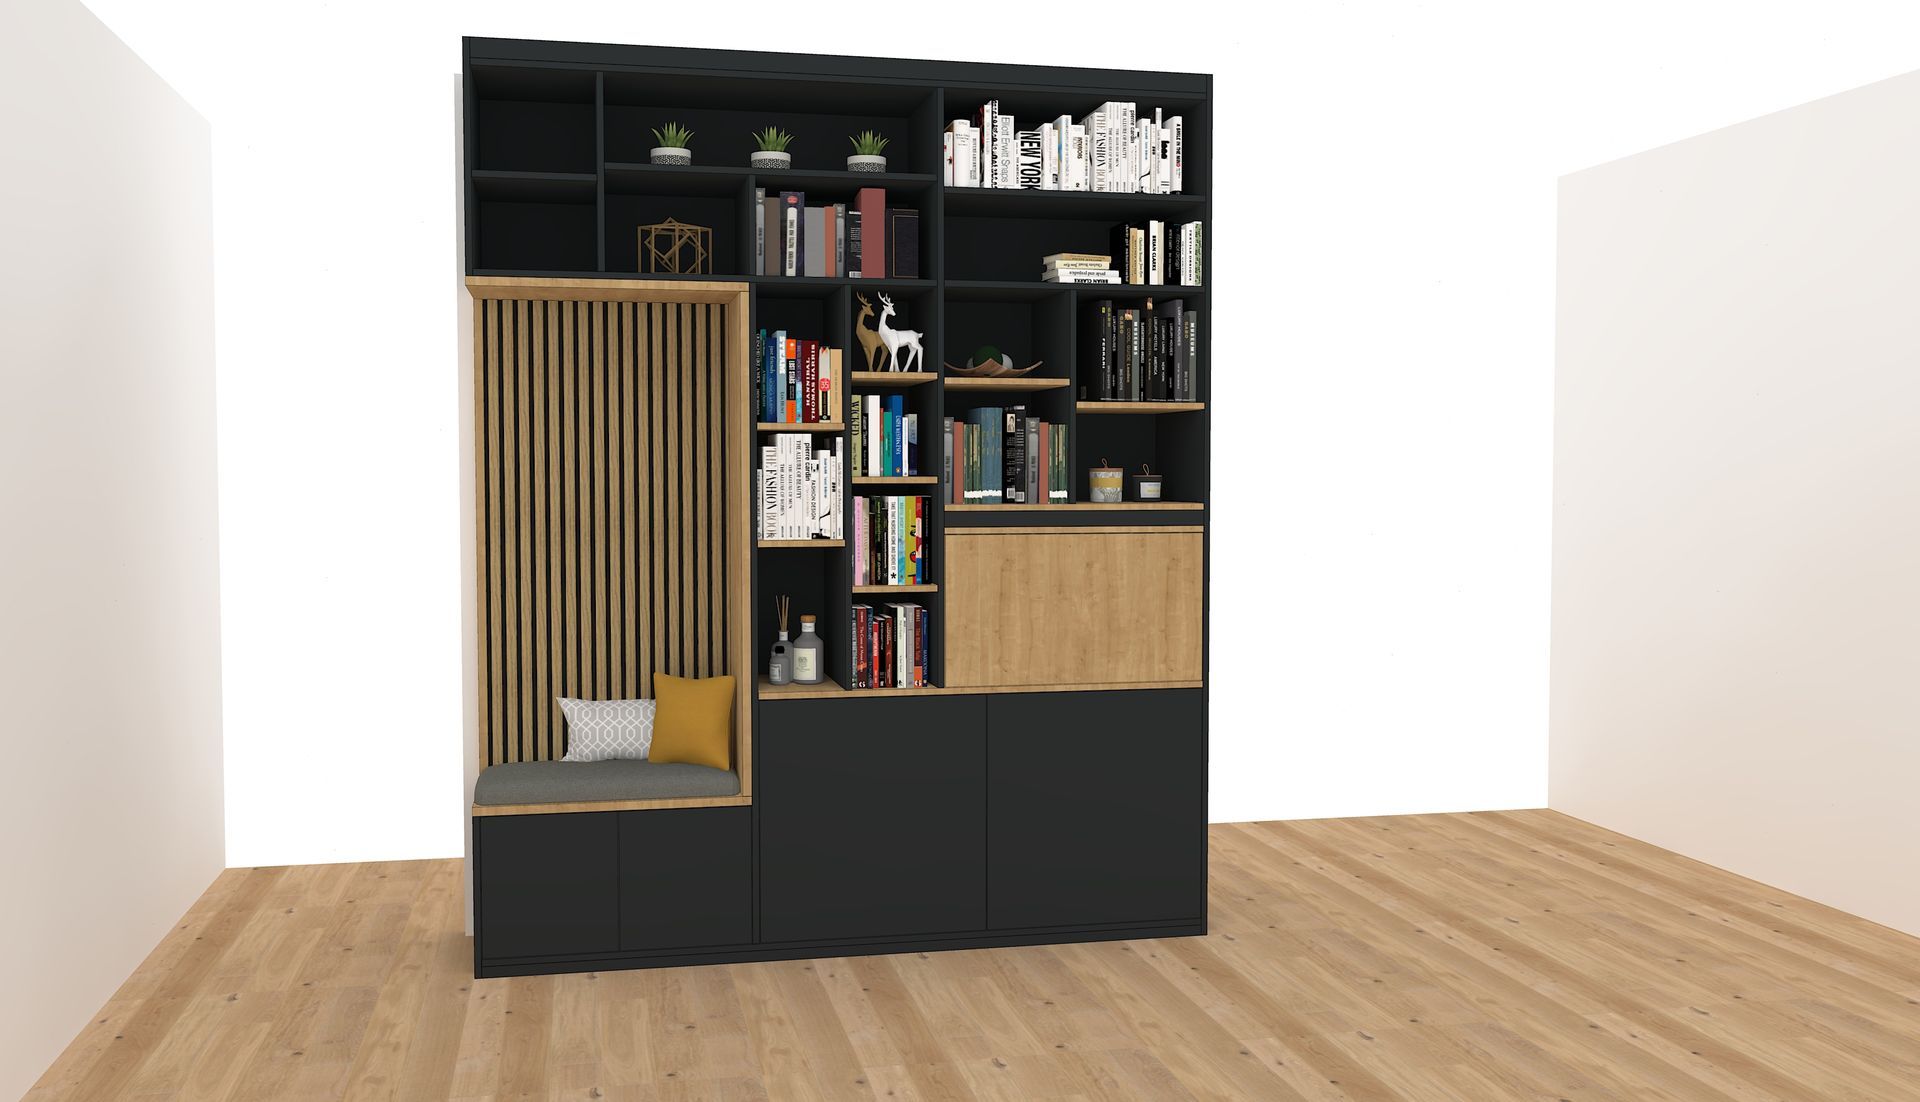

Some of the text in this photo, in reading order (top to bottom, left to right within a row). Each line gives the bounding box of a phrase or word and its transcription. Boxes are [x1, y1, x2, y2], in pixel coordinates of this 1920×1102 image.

[1001, 117, 1011, 182] Elliott Erwitt Snaps
[1020, 132, 1041, 190] NEW YORK
[1096, 113, 1106, 192] THE FASHION BOOK
[768, 355, 776, 374] friends
[851, 400, 860, 436] WICKED
[766, 447, 777, 538] THE FASHION BOOK
